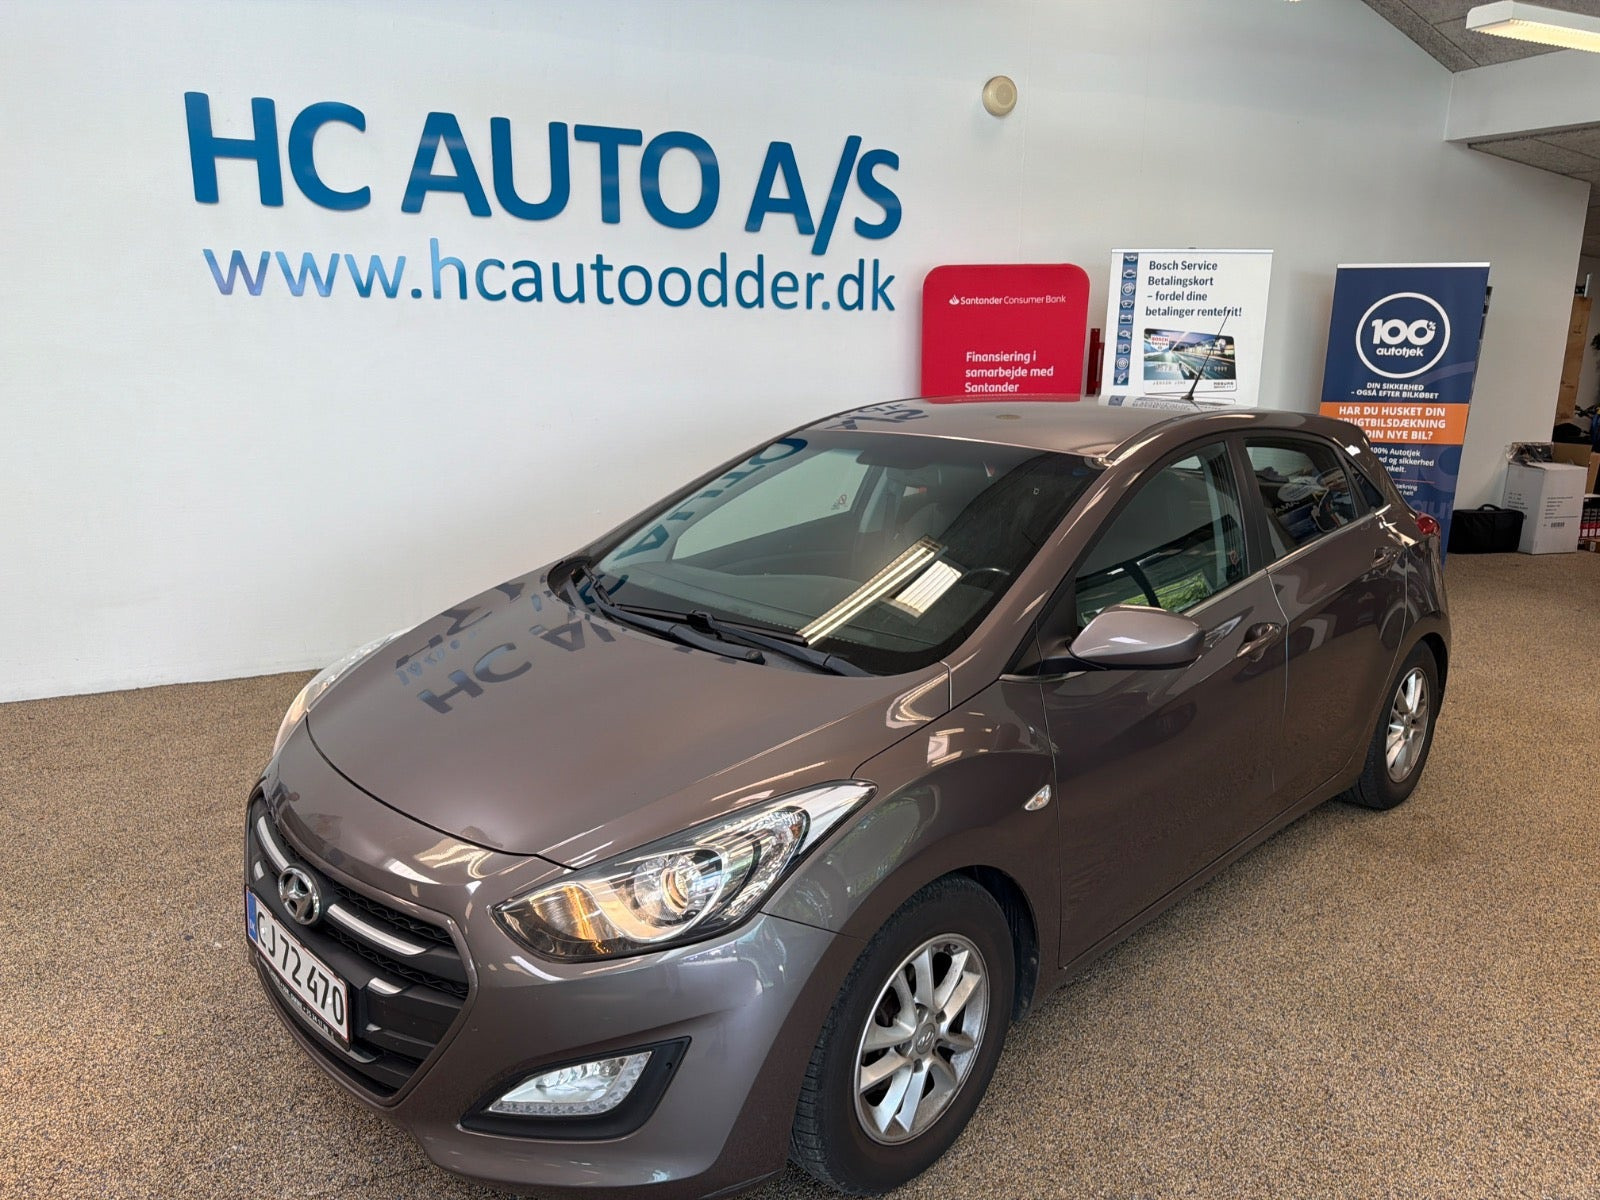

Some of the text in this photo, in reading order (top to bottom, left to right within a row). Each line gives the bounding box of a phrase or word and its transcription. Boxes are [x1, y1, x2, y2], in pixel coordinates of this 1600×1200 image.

[184, 91, 903, 256] HC AUTO A/S
[1148, 260, 1218, 271] Bosch Service
[203, 238, 896, 313] www.hcautoodder.dk
[1147, 276, 1214, 288] Betalingskort
[960, 294, 1066, 306] Santander Consumer Bank
[1155, 291, 1184, 301] fordel
[1186, 291, 1208, 301] dine
[1145, 306, 1242, 318] betalinger rentefrit!
[965, 350, 1037, 365] Finansiering i
[1375, 346, 1424, 358] autotjek
[965, 365, 1054, 380] samarbejde med
[964, 381, 1020, 393] Santander
[1366, 382, 1425, 391] DIN SIKKERHED
[1356, 388, 1377, 397] OGSÅ
[1378, 390, 1401, 398] EFTER
[1338, 406, 1446, 417] HAR DU HUSKET DIN
[1386, 430, 1408, 440] NYE
[1411, 430, 1433, 441] BIL?
[1390, 448, 1421, 459] Autotjek
[1388, 457, 1398, 466] og
[1399, 457, 1435, 467] sikkerhed
[257, 911, 345, 1026] CJ 72 470
